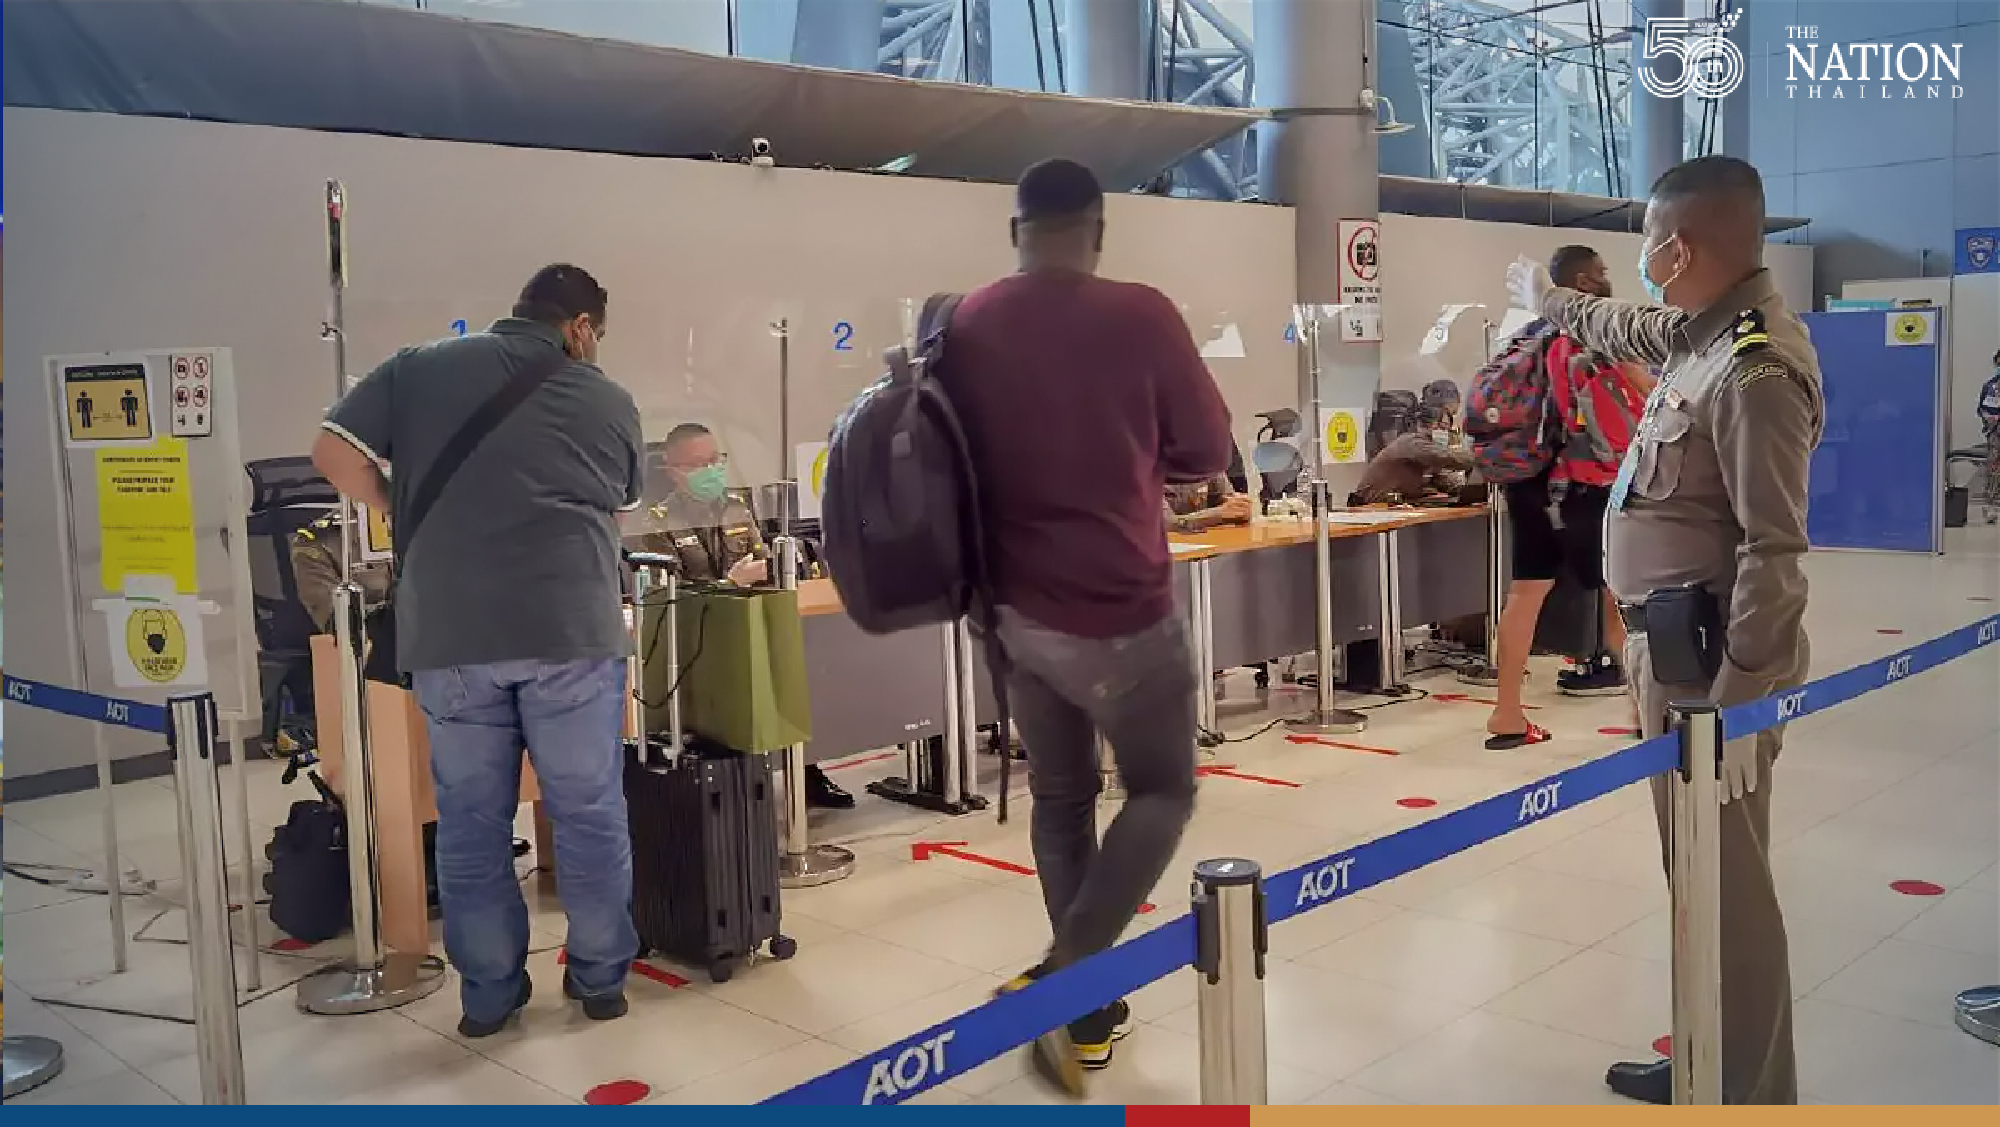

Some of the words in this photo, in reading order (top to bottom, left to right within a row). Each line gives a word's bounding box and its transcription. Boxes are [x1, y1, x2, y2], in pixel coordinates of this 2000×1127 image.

[833, 322, 854, 351] 2
[1977, 619, 1998, 644] AOT
[1887, 655, 1911, 681] AOT
[8, 680, 33, 702] AOT
[1777, 690, 1807, 720] AOT
[106, 700, 130, 722] AOT
[1518, 780, 1562, 820] AOT
[1297, 857, 1355, 905] AOT
[862, 1030, 955, 1105] AOT
